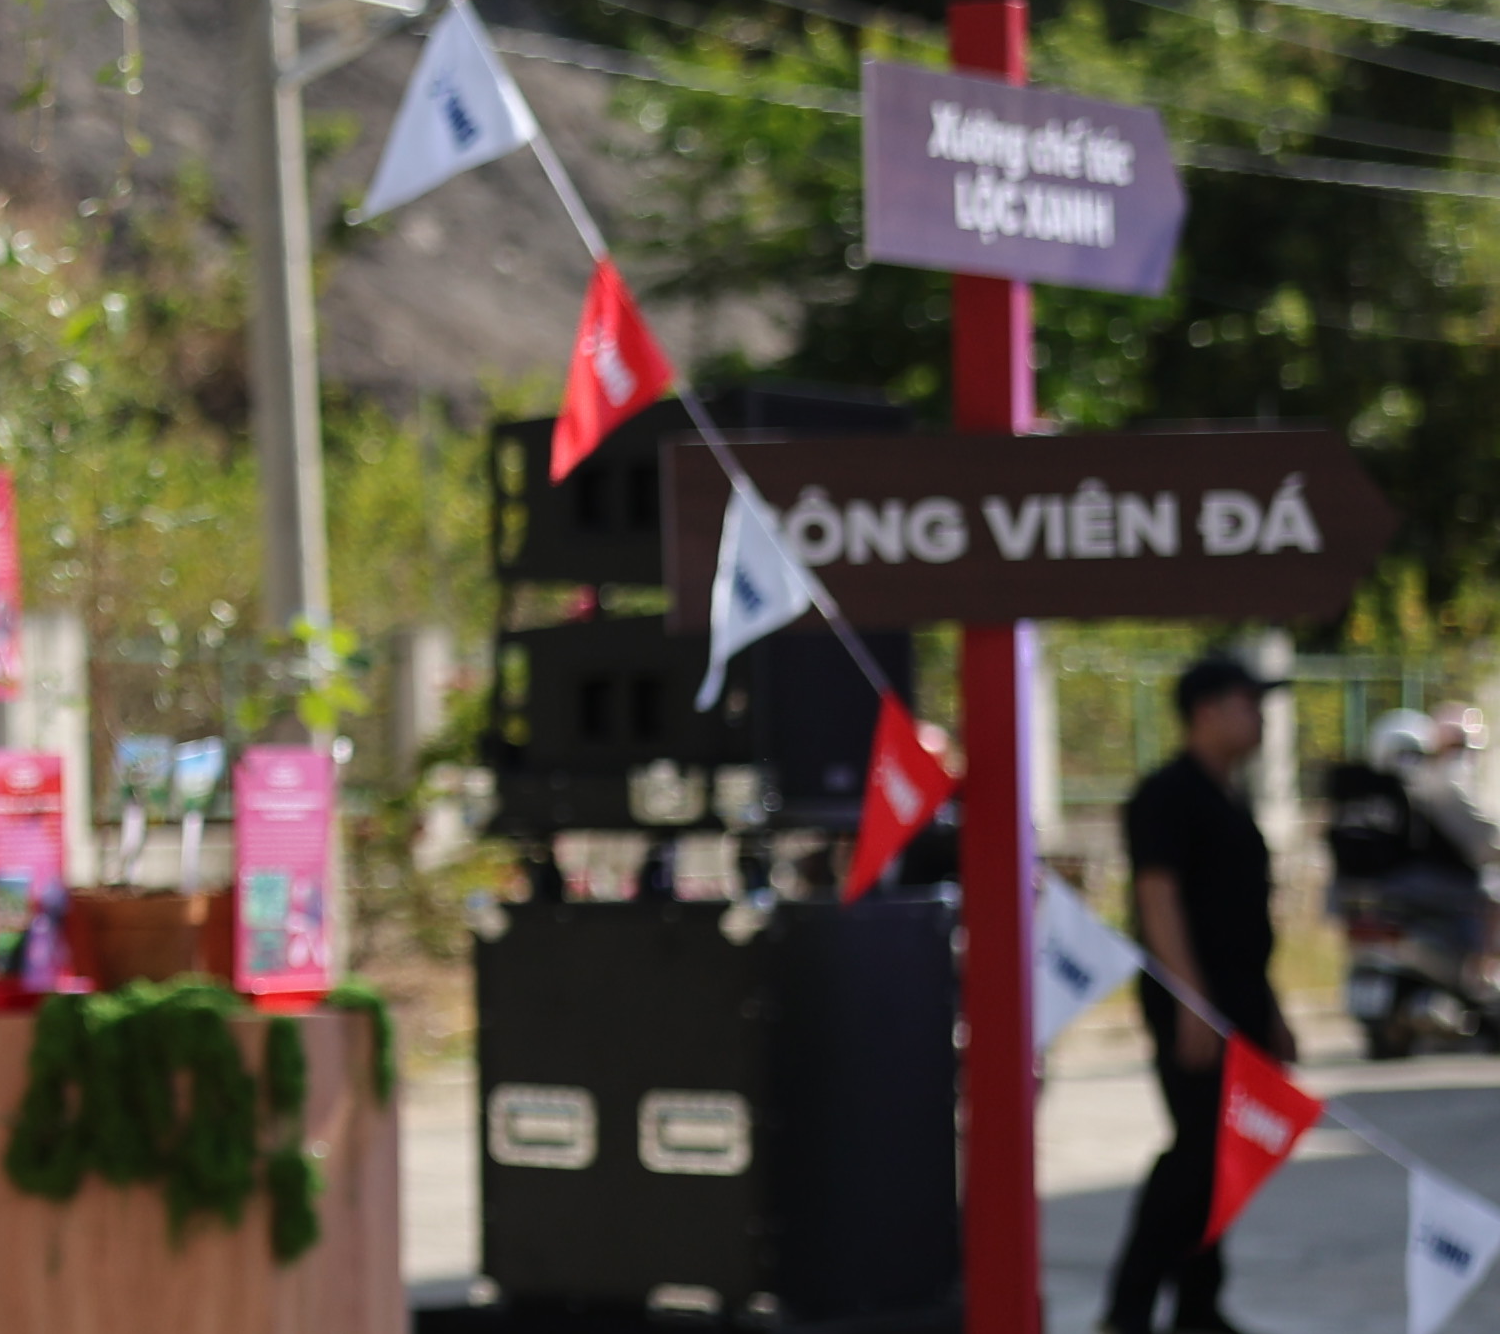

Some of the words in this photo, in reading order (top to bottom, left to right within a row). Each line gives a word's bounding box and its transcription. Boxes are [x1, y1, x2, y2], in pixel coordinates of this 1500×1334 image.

[772, 486, 968, 565] ÔNG
[981, 477, 1180, 560] VIÊN
[1198, 472, 1323, 556] ĐÁ
